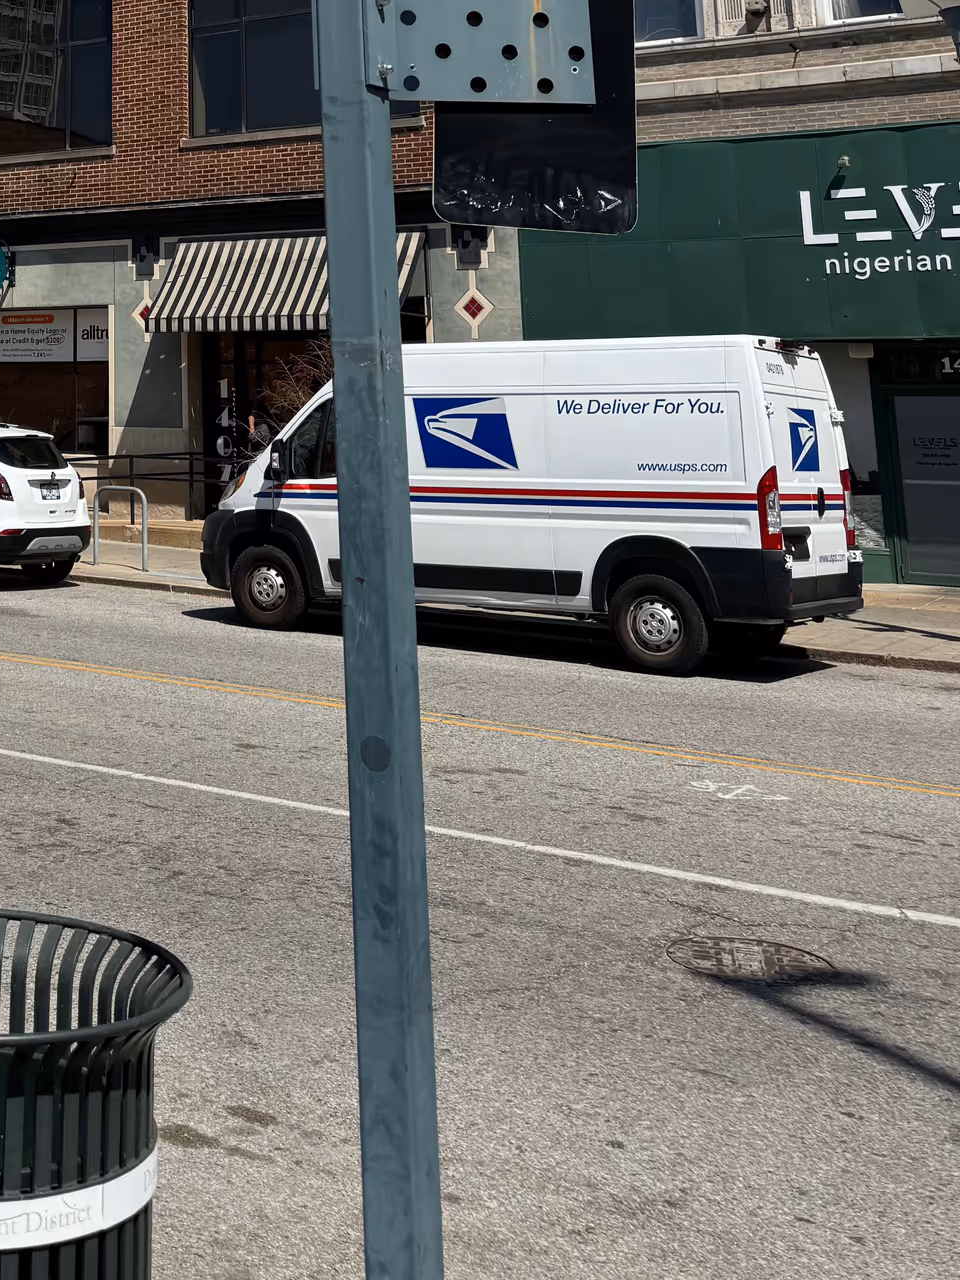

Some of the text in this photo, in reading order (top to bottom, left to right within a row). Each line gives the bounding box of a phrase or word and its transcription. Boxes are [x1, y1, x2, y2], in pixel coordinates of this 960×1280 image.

[825, 249, 952, 280] nigerian
[27, 327, 45, 336] Equity
[46, 327, 60, 335] Loan
[12, 337, 30, 345] Credit
[35, 337, 45, 346] get
[556, 398, 725, 415] We Deliver For You.
[913, 437, 958, 448] LEVELS
[637, 462, 728, 474] www.usps.com
[24, 1203, 94, 1234] District
